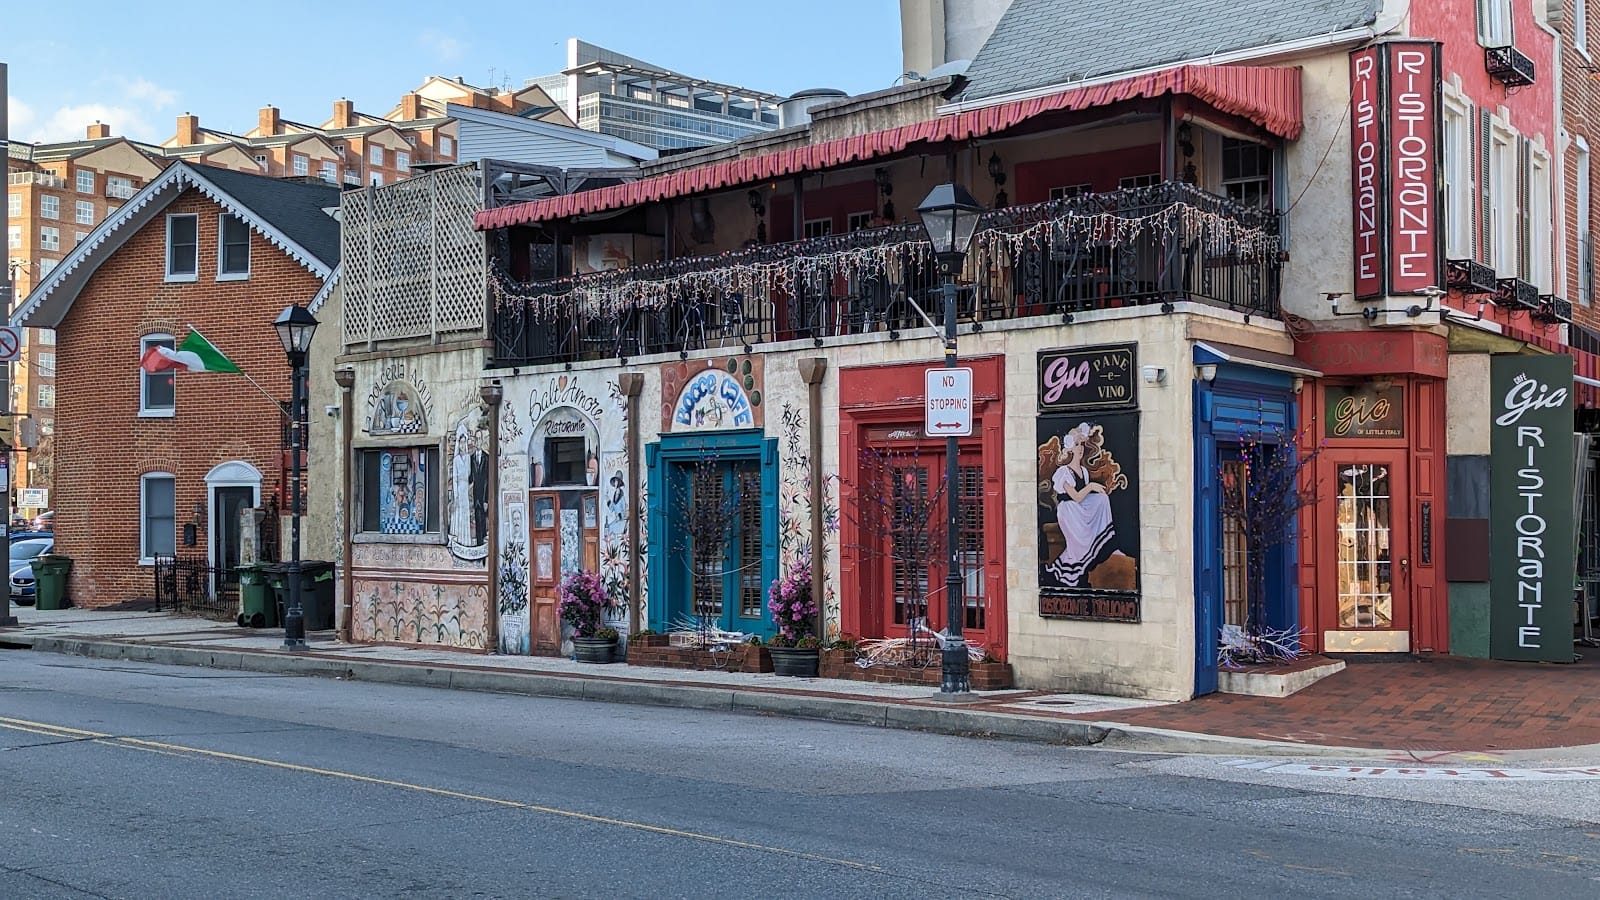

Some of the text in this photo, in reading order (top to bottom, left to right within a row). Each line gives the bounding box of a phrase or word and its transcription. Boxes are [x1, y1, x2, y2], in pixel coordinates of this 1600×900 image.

[1092, 354, 1130, 372] PANE
[942, 375, 955, 388] NO
[1097, 385, 1126, 399] VINO
[930, 398, 968, 410] STOPPING
